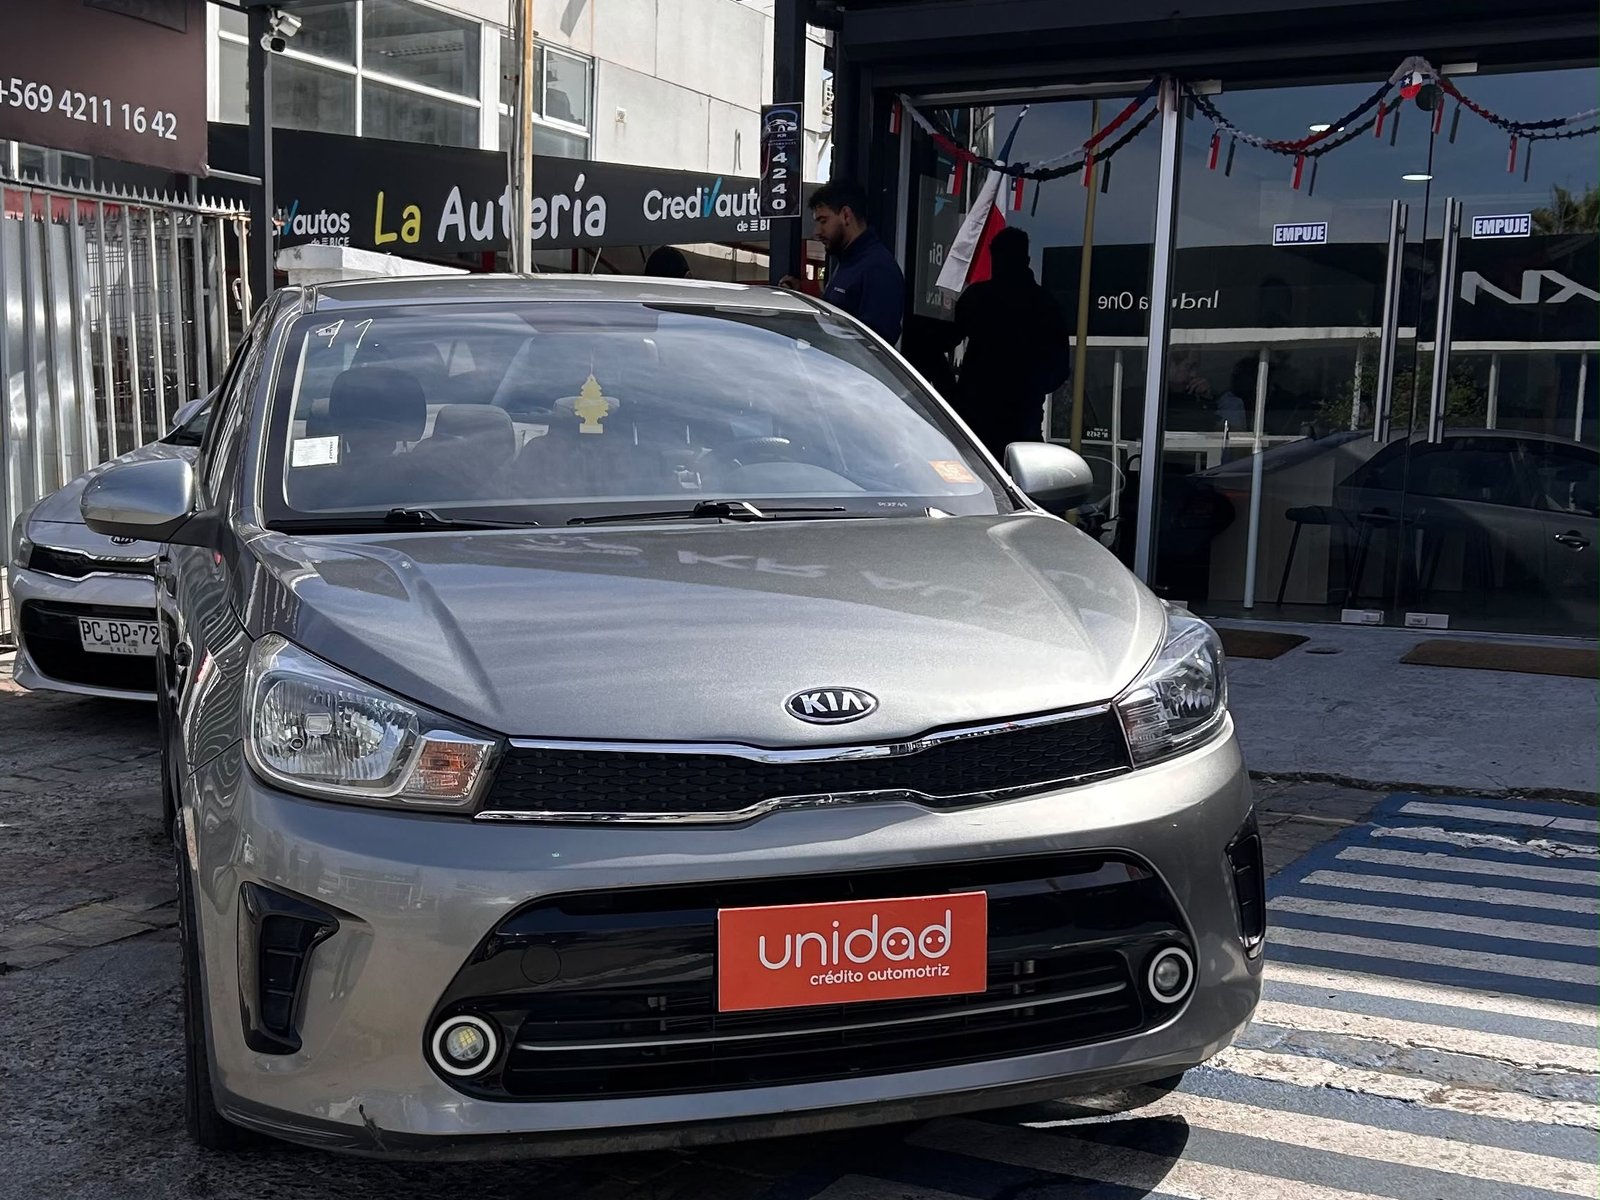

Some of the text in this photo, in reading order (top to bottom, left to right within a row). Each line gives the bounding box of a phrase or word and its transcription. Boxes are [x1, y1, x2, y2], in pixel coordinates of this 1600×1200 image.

[58, 90, 112, 126] 4211
[121, 103, 147, 134] 16
[151, 110, 177, 140] 42
[374, 173, 607, 246] La Autería
[736, 219, 770, 232] de BI
[1275, 225, 1325, 242] EMPUJE
[1474, 216, 1529, 235] EMPUJE
[329, 237, 350, 247] BICE
[798, 691, 865, 715] KIA
[758, 908, 952, 970] unidad
[809, 963, 951, 986] crédito automotriz
